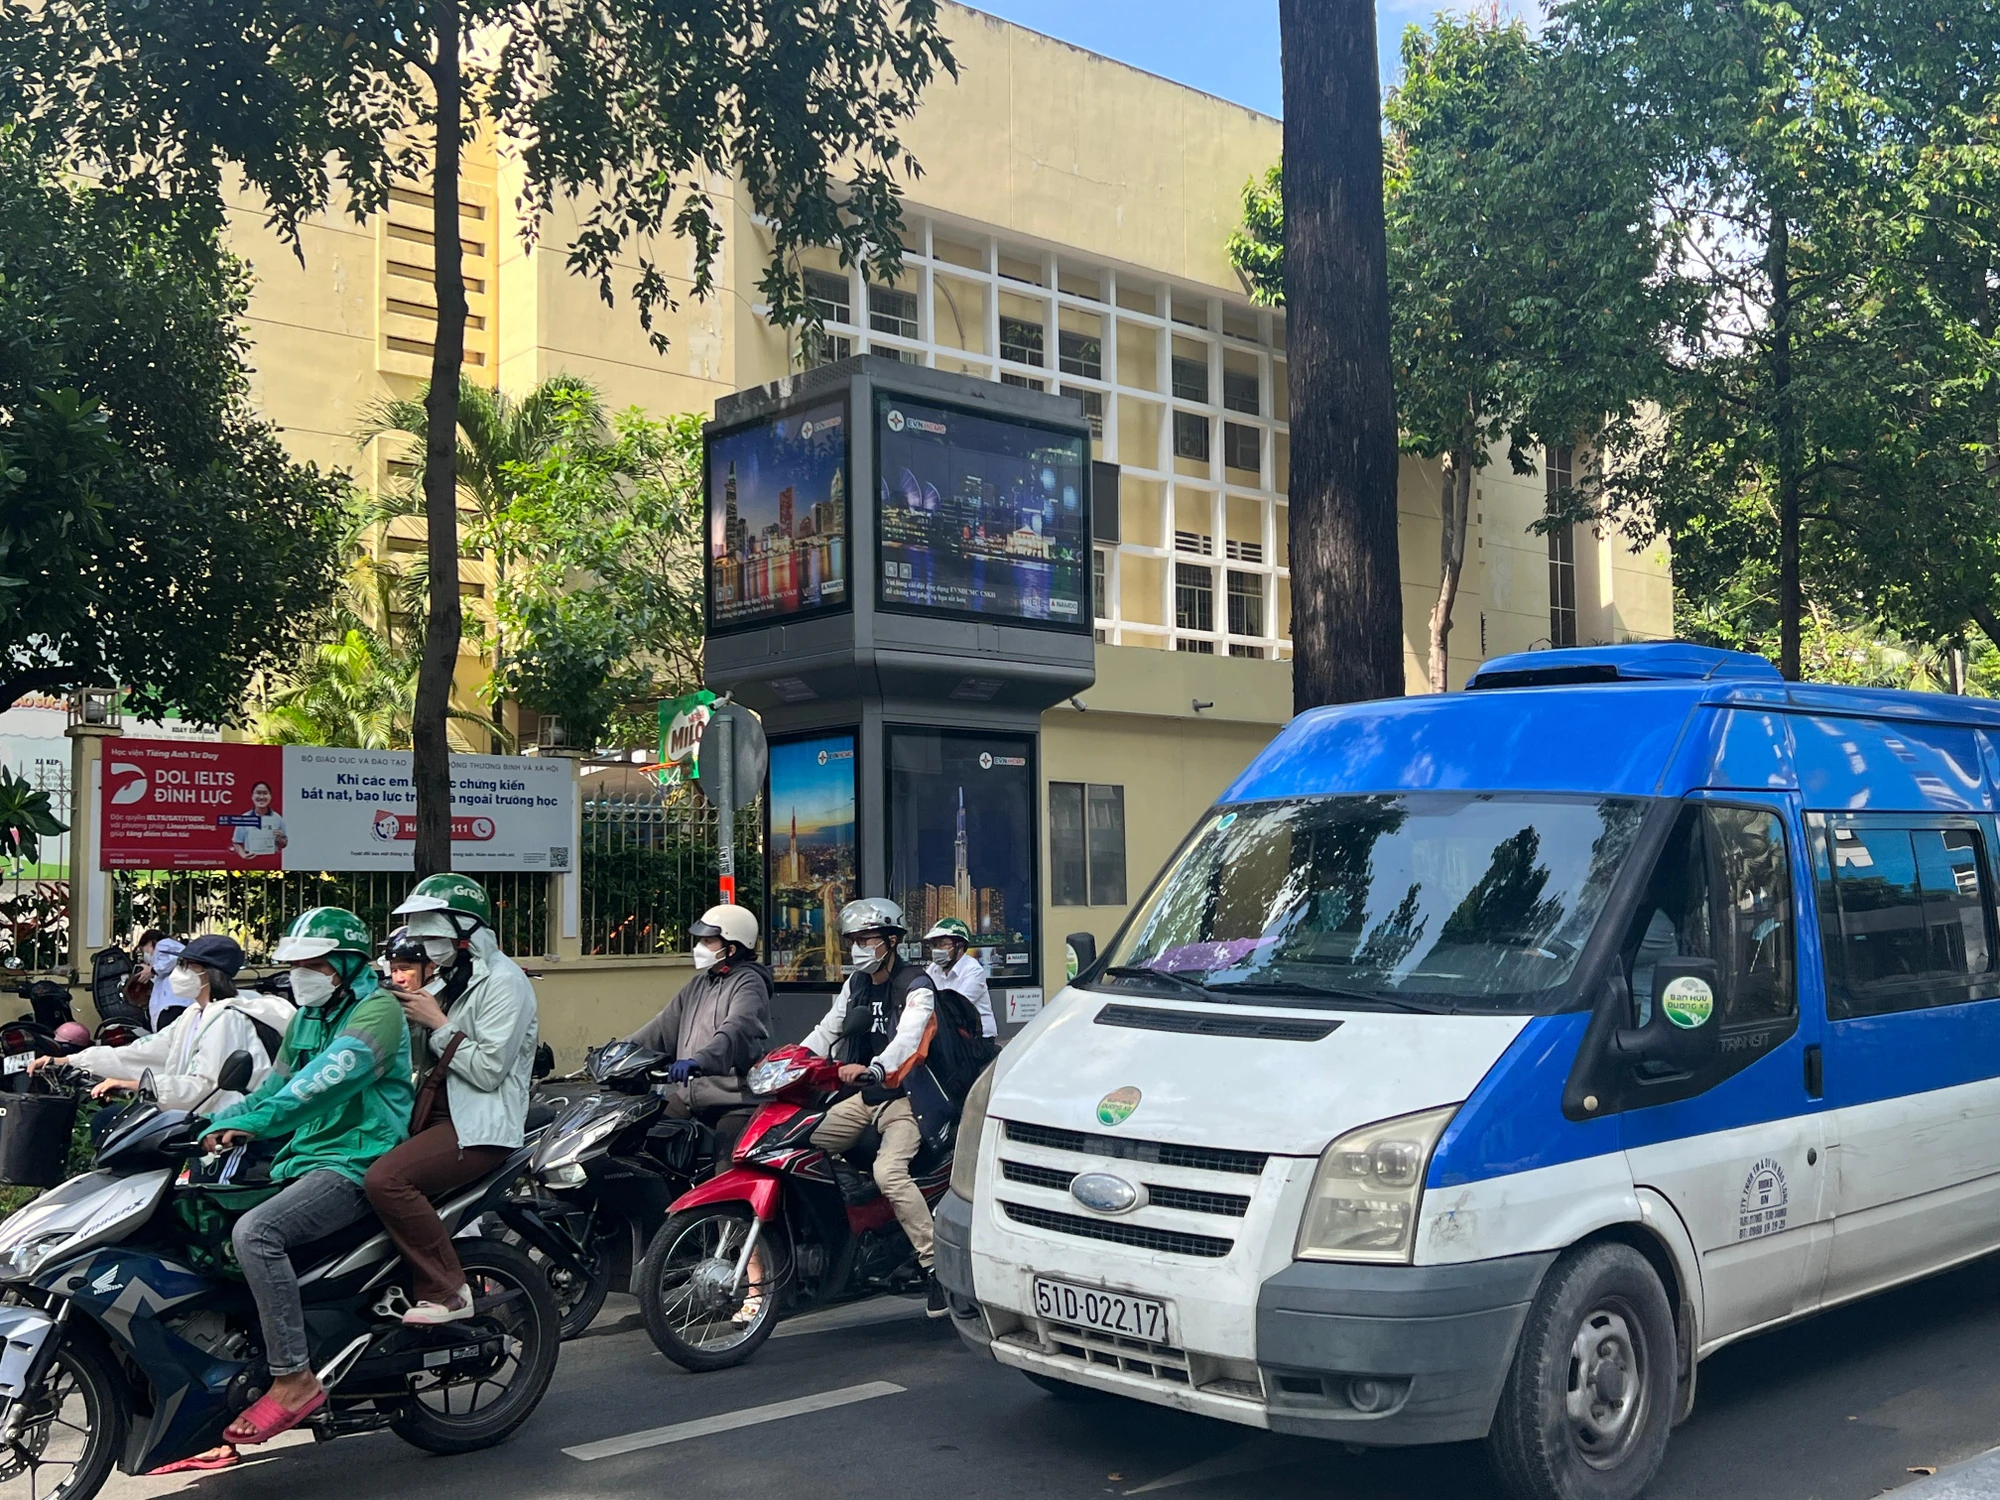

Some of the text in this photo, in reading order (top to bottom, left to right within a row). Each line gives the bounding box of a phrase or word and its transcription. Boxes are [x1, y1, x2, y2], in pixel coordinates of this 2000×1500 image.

[111, 749, 127, 758] Học
[146, 749, 170, 760] Tiếng
[171, 750, 189, 758] Anh
[202, 752, 219, 761] Duy
[503, 763, 520, 771] BINH
[155, 769, 235, 786] DOL IELTS
[337, 773, 359, 785] Khi
[362, 774, 386, 786] các
[389, 777, 408, 787] em
[459, 778, 497, 792] chứng
[500, 779, 525, 790] kiến
[154, 785, 233, 807] ĐÌNH LỰC
[301, 786, 323, 800] bắt
[327, 788, 352, 802] nạt,
[355, 789, 379, 803] bạo
[383, 790, 402, 804] lực
[459, 793, 493, 806] ngoài
[495, 793, 534, 807] trường
[536, 795, 558, 808] học
[450, 824, 468, 833] 111
[453, 885, 485, 903] Grab
[343, 927, 369, 944] Grab
[291, 1049, 356, 1102] Grab
[93, 1283, 124, 1295] HONDA
[1038, 1282, 1159, 1337] 51D-022.17
